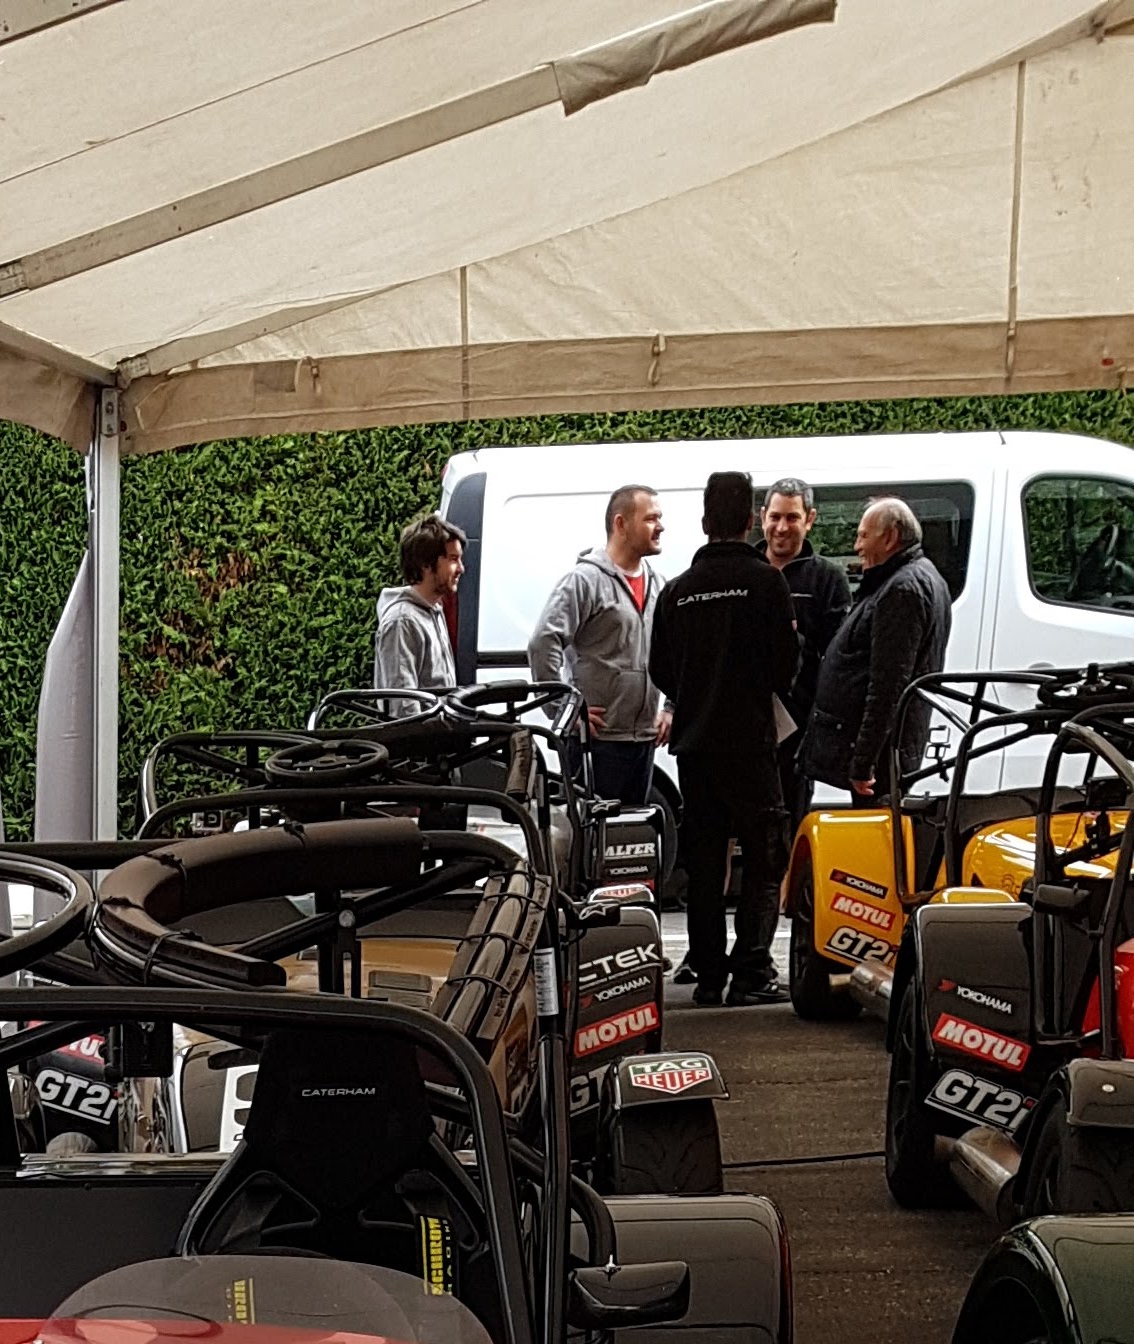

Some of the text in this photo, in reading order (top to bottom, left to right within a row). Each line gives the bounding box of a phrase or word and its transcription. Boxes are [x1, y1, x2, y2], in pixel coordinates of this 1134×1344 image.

[677, 588, 748, 606] CATERHAM
[605, 843, 655, 856] ALFER
[846, 876, 884, 896] YOKOHAMA
[833, 897, 892, 928] MOTUL
[594, 976, 651, 1002] YOKOHAMA
[957, 985, 1013, 1014] YOKOHAMA
[578, 1007, 657, 1052] MOTUL
[938, 1019, 1024, 1067] MOTUL
[633, 1058, 704, 1073] TAG
[301, 1087, 376, 1097] CATERHAM
[635, 1069, 710, 1091] HEUER
[35, 1069, 120, 1120] GT2i
[934, 1070, 1036, 1129] GT2i
